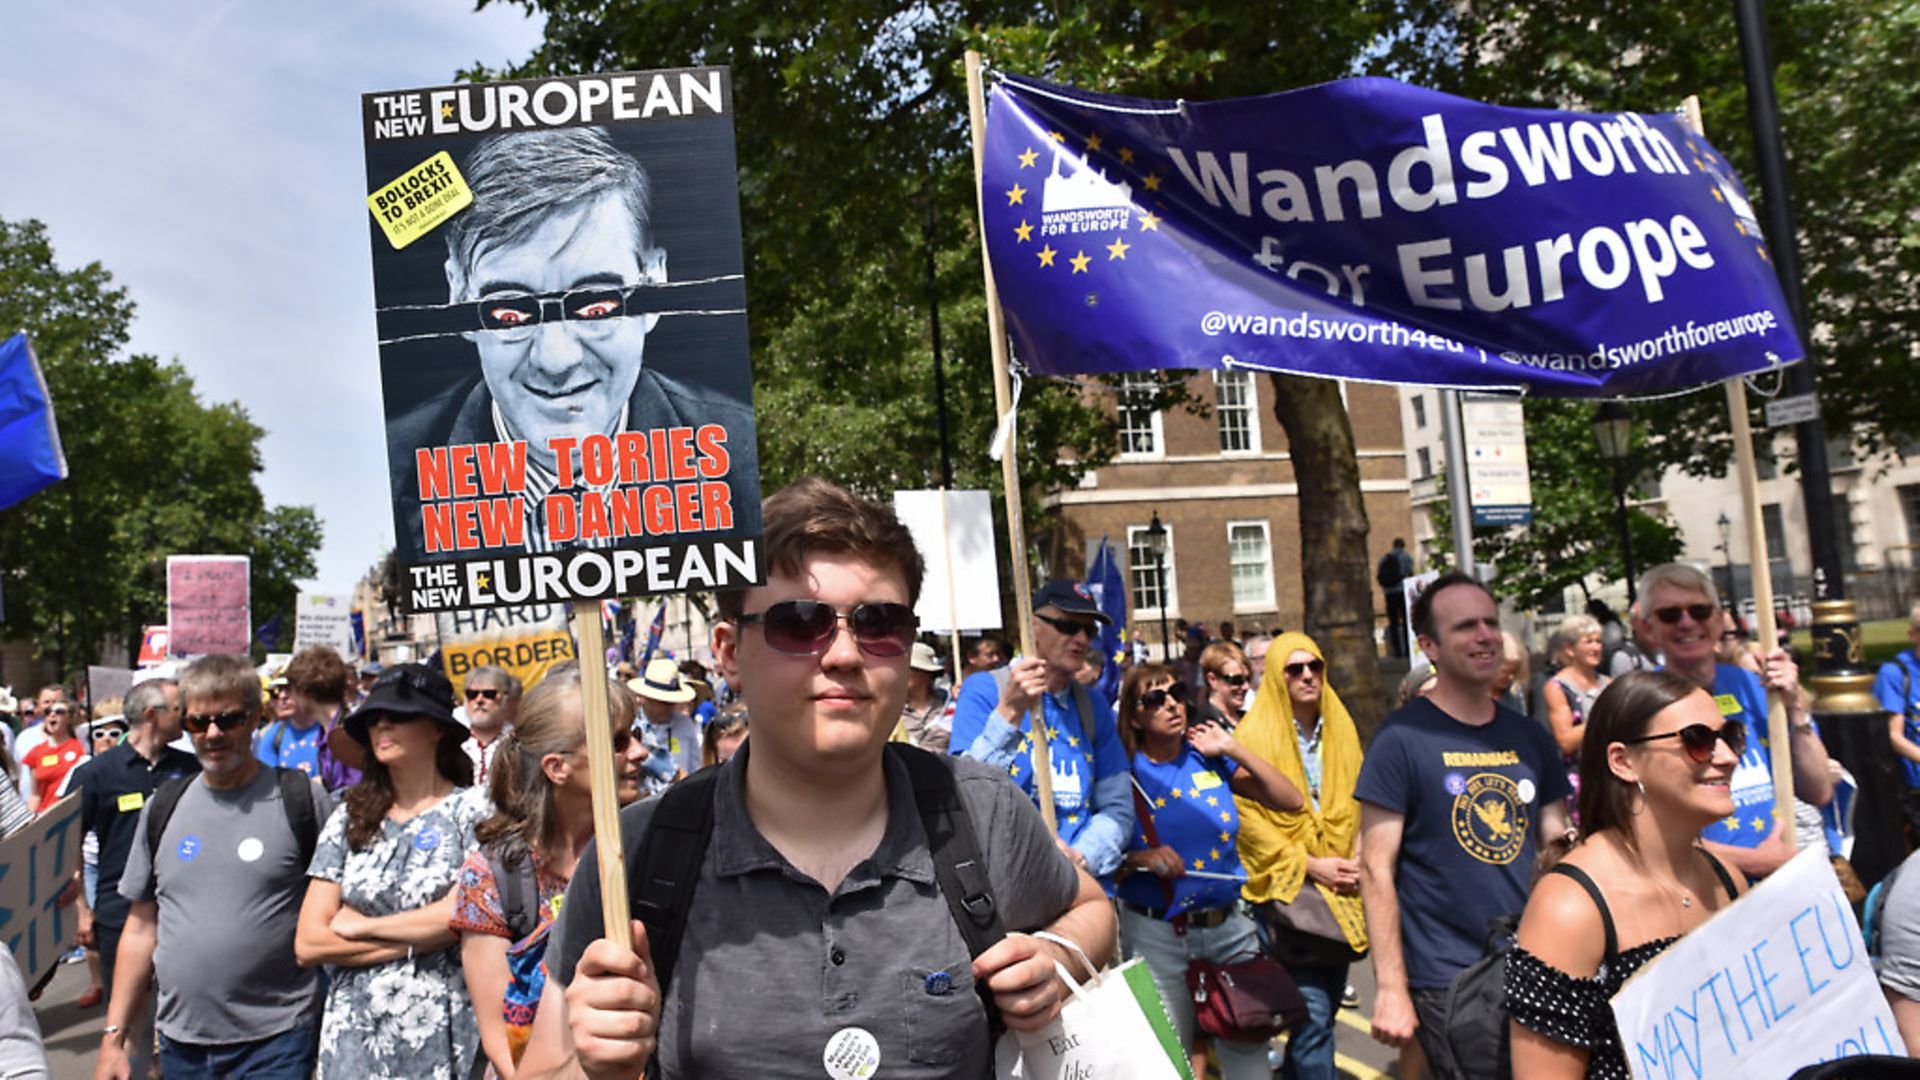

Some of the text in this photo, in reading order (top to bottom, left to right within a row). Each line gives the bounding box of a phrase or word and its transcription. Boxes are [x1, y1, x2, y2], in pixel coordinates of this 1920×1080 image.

[373, 93, 421, 119] THE
[430, 71, 723, 134] EUROPEAN
[375, 114, 428, 139] NEW
[375, 159, 445, 210] BOLLOCKS
[1167, 112, 1690, 222] Wandsworth
[382, 205, 403, 224] TO
[404, 171, 453, 210] BREXIT
[1042, 208, 1129, 225] WANDSWORTH
[1041, 218, 1128, 237] FOR EUROPE
[1254, 214, 1715, 313] for Europe
[416, 424, 731, 500] NEW TORIES
[422, 481, 734, 554] NEW DANGER
[410, 564, 458, 589] THE
[466, 540, 758, 607] EUROPEAN
[412, 586, 463, 610] NEW
[454, 603, 552, 634] HARD
[449, 638, 570, 675] BORDER
[1790, 891, 1855, 996] EU
[1046, 1034, 1080, 1056] Eat
